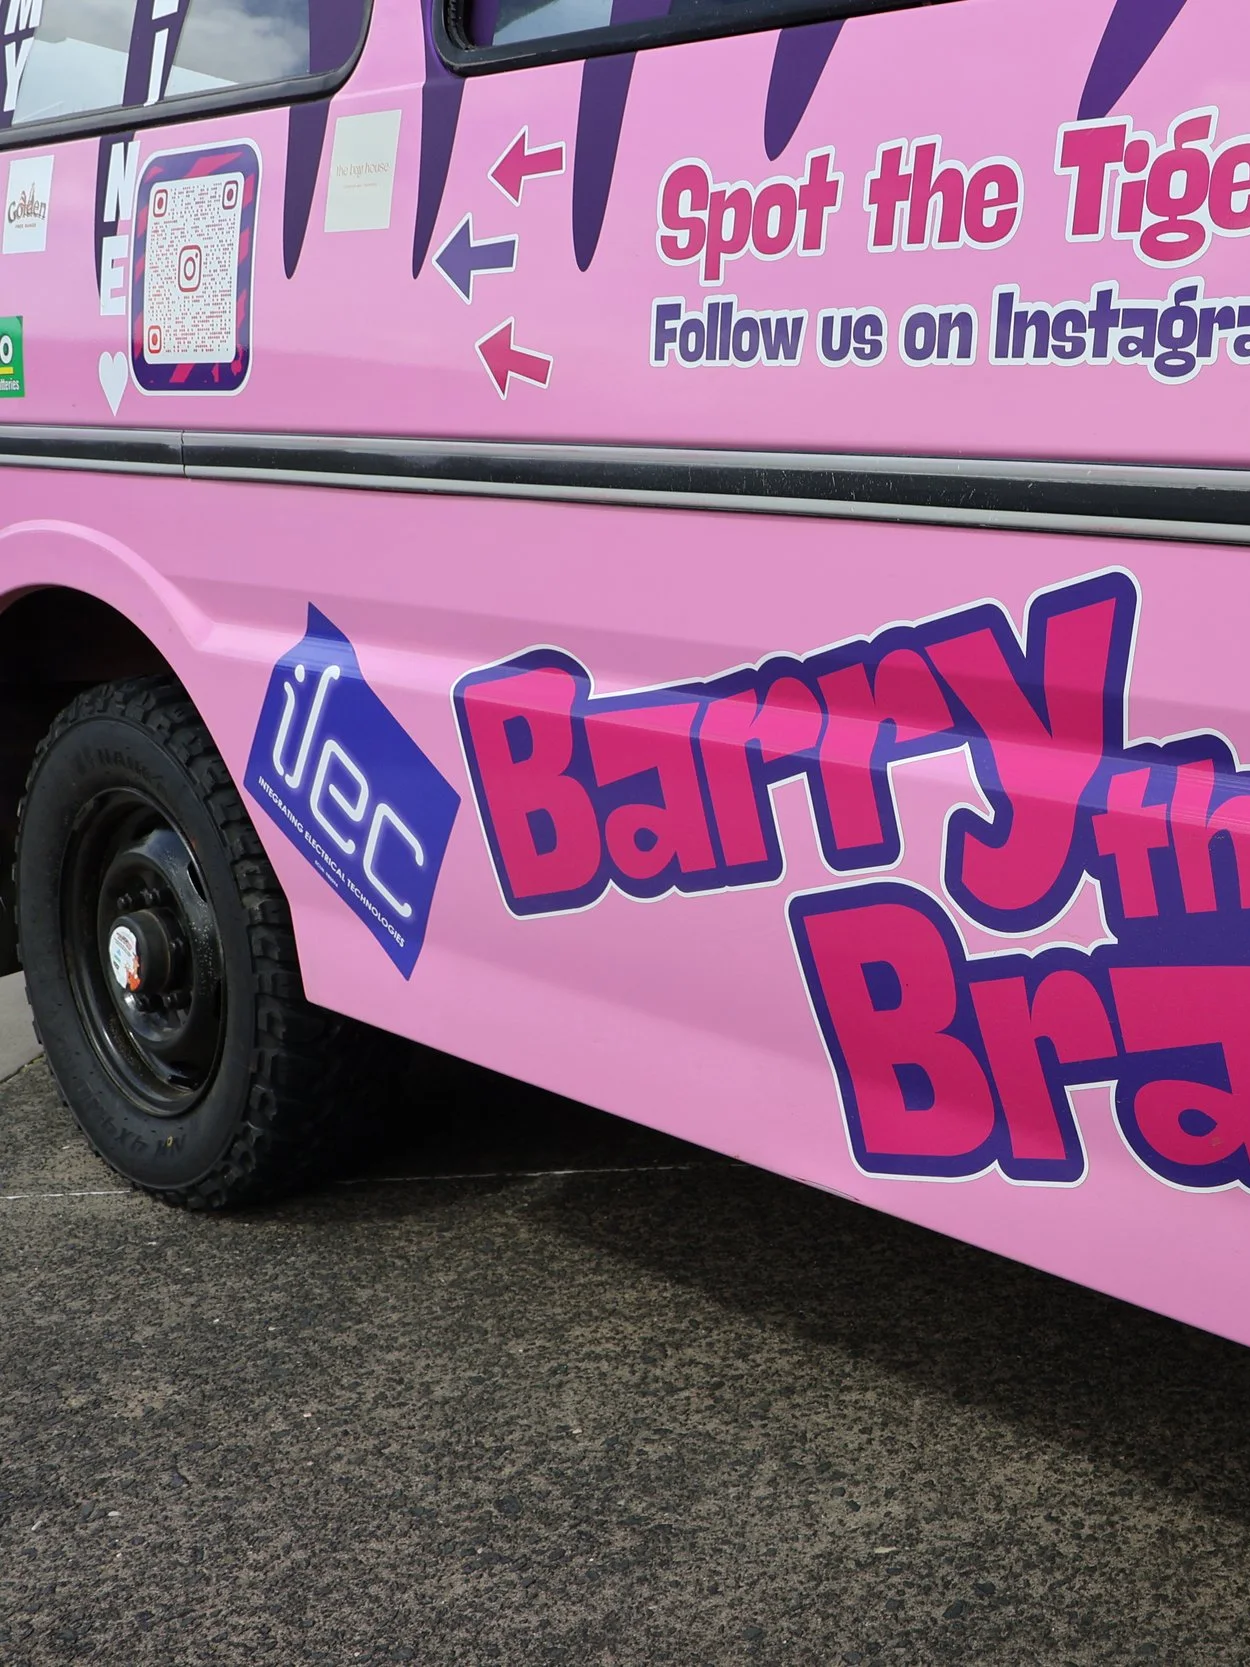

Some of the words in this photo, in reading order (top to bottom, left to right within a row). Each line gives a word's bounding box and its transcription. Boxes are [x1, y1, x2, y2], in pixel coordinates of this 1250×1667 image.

[7, 181, 47, 223] Golden
[660, 150, 840, 282] Spot
[867, 140, 1019, 247] the
[653, 301, 803, 362] Follow
[820, 308, 883, 361] us
[904, 310, 972, 360] on
[462, 596, 1118, 912] Barry
[258, 776, 304, 833] INTEGRATING
[304, 830, 346, 883] ELECTRICAL
[346, 878, 405, 948] TECHNOLOGIES
